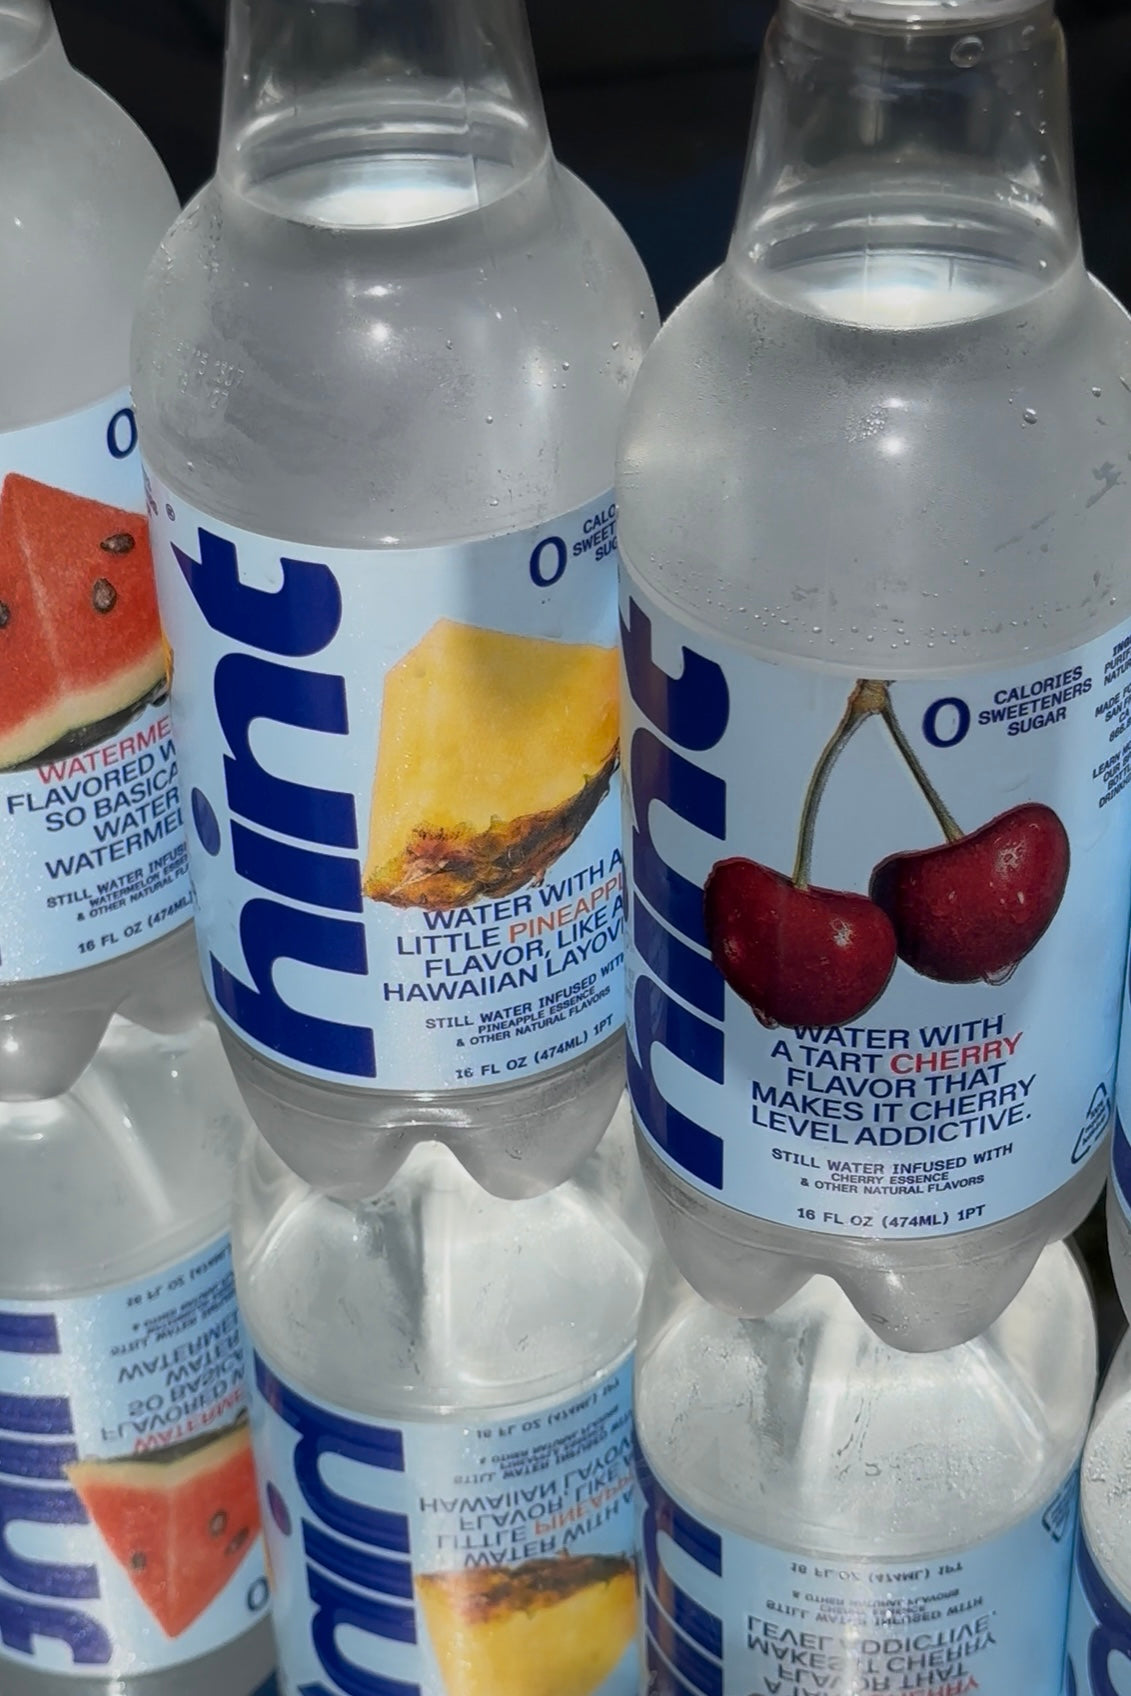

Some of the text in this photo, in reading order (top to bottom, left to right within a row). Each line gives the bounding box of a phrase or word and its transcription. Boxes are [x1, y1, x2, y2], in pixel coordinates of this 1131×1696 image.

[978, 678, 1092, 726] SWEETENERS
[994, 665, 1083, 705] CALORIES
[1095, 692, 1120, 718] MADE
[1007, 706, 1067, 736] SUGAR
[1105, 701, 1122, 722] SAN
[37, 716, 172, 784] WATERME
[1093, 751, 1121, 779] LEARN
[7, 753, 155, 814] FLAVORED
[1104, 762, 1120, 782] OUR
[46, 762, 178, 832] SO BASICA
[94, 786, 180, 842] WATER
[170, 526, 378, 1079] hint
[46, 889, 92, 908] STILL
[96, 868, 144, 894] WATER
[76, 912, 86, 922] &
[89, 900, 127, 918] OTHER
[130, 876, 173, 903] NATURAL
[89, 872, 160, 908] WATERMELON
[423, 848, 624, 931] WATER WITH A
[77, 940, 96, 954] 16
[100, 933, 119, 948] FL
[124, 921, 142, 938] OZ
[397, 927, 501, 956] LITTLE
[425, 894, 623, 978] FLAVOR, LIKE A
[383, 964, 538, 1002] HAWAIIAN
[425, 1016, 475, 1029] STILL
[479, 1002, 532, 1024] WATER
[538, 973, 598, 1009] INFUSED
[456, 986, 611, 1048] & OTHER NATURAL FLAVORS
[478, 986, 596, 1035] PINEAPPLE ESSENCE
[456, 1013, 615, 1080] 16 FL OZ (474ML) 1PT
[794, 1014, 1006, 1050] WATER WITH
[770, 1031, 1024, 1075] A TART CHERRY
[752, 1080, 864, 1122] MAKES
[874, 1102, 904, 1122] IT
[909, 1074, 1037, 1122] CHERRY
[787, 1062, 1008, 1098] FLAVOR THAT
[752, 1104, 849, 1144] LEVEL
[854, 1102, 1032, 1146] ADDICTIVE.
[771, 1142, 1014, 1176] STILL WATER INFUSED WITH
[830, 1170, 950, 1185] CHERRY ESSENCE
[800, 1174, 985, 1196] & OTHER NATURAL FLAVORS
[796, 1204, 986, 1230] 16 FL OZ (474ML) 1PT
